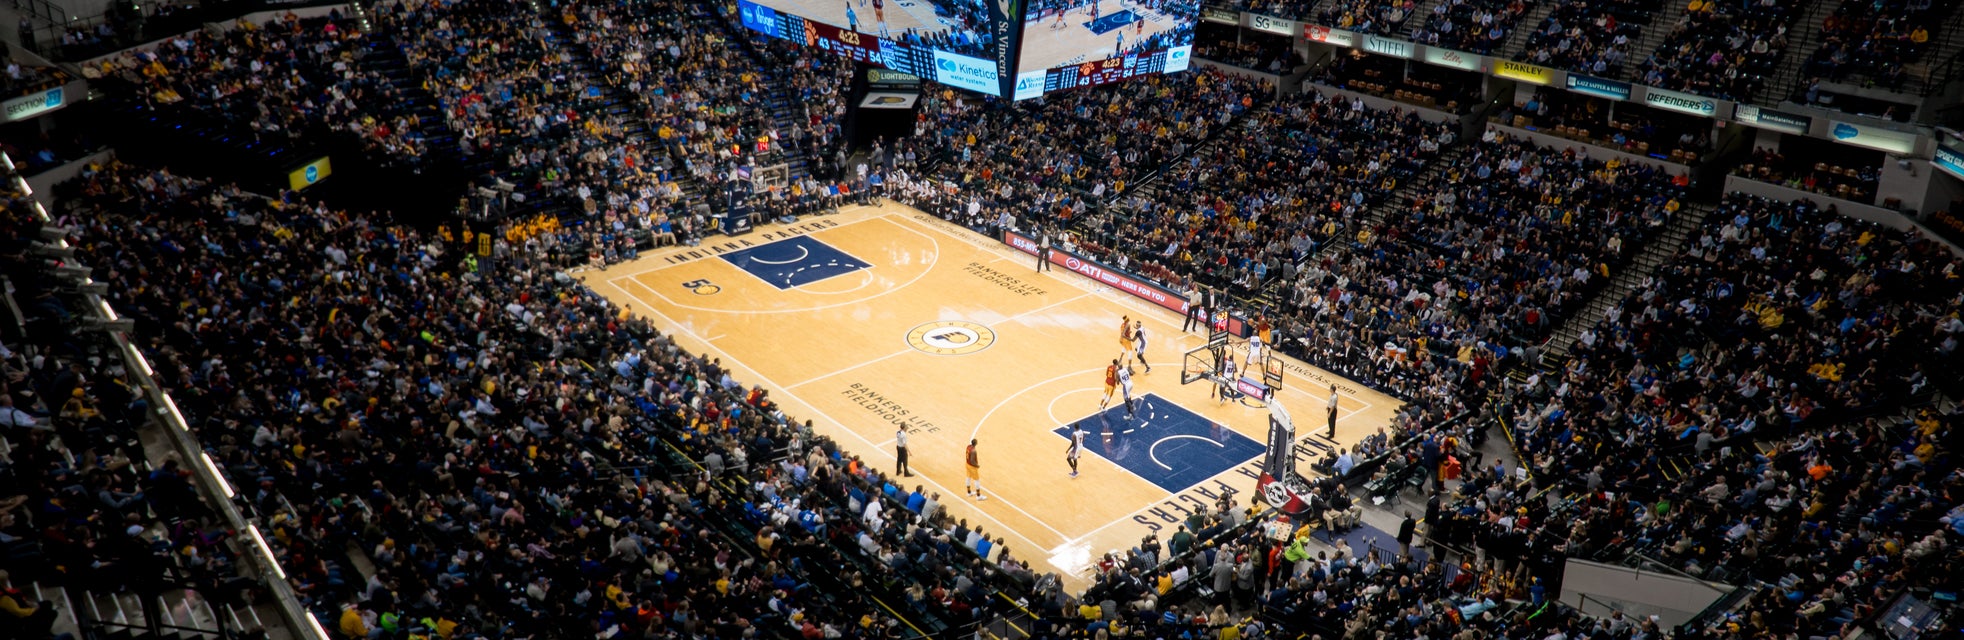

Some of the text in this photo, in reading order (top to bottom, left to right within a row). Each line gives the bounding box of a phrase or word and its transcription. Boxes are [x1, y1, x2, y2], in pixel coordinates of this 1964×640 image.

[1255, 15, 1288, 29] SG SELLS
[818, 36, 830, 50] 43
[838, 29, 860, 46] 4:23
[868, 49, 882, 64] 54
[998, 20, 1009, 78] St. Vincent
[1101, 57, 1121, 68] 4:23
[1503, 62, 1543, 75] STANLEY
[958, 63, 997, 81] Kinetico
[1122, 69, 1133, 78] 54
[1078, 76, 1090, 86] 43
[7, 95, 46, 116] SECTION
[1646, 92, 1701, 110] DEFENDERS
[664, 219, 839, 264] INDIANA PACERS
[968, 261, 1048, 296] BANKERS LIFE
[1079, 263, 1102, 278] ATI
[963, 266, 1033, 297] FIELDHOUSE
[1138, 286, 1151, 297] FOR
[1151, 290, 1166, 303] YOU
[1121, 373, 1130, 381] 43
[849, 382, 941, 434] BANKERS LIFE
[1133, 479, 1240, 531] PACERS
